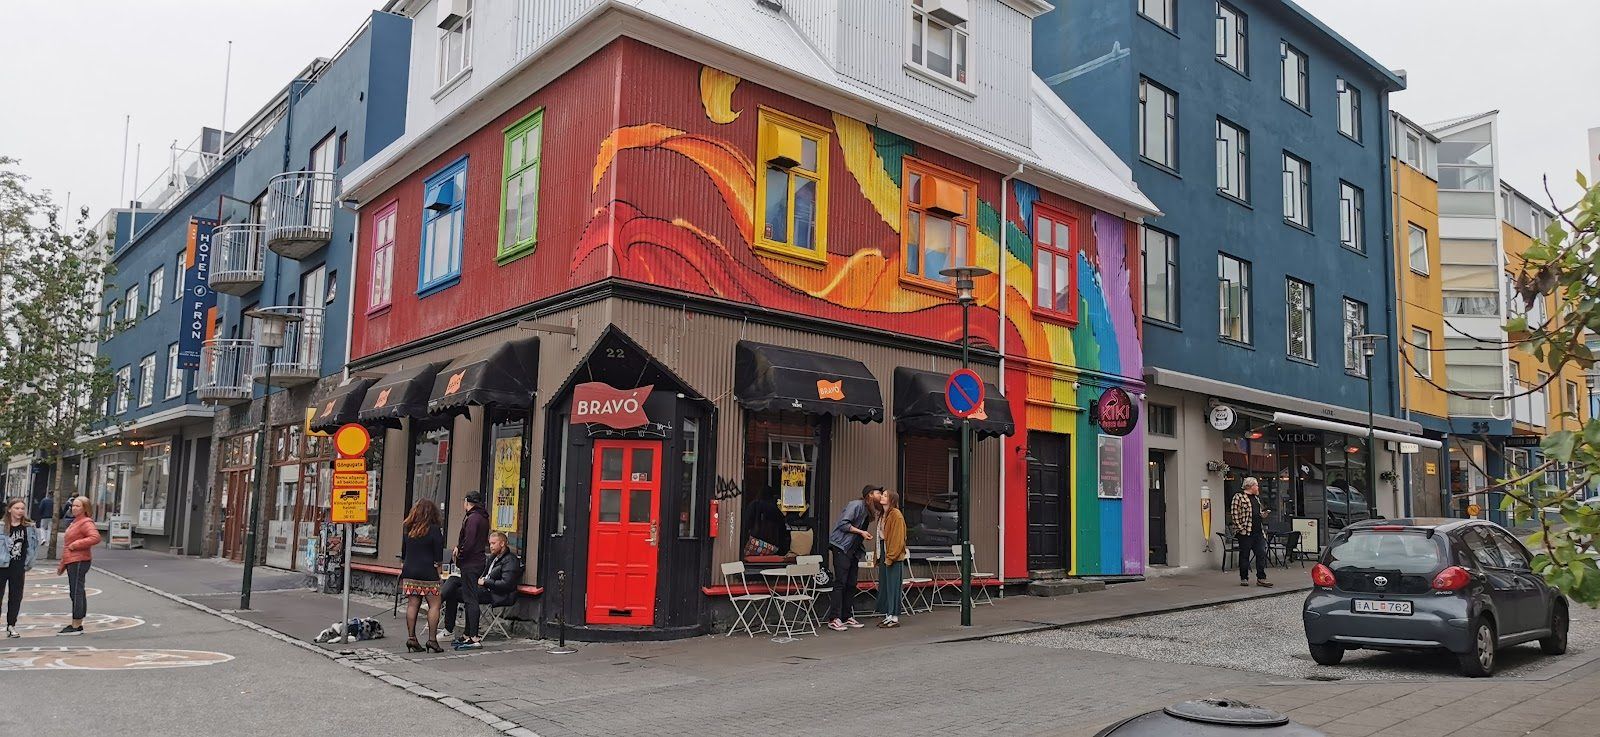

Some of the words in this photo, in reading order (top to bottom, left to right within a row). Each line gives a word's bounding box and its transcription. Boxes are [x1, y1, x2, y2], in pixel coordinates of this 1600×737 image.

[198, 234, 210, 280] HÓTEL
[191, 301, 203, 340] FRÓN
[606, 347, 625, 359] 22
[577, 391, 639, 416] BRAVÓ
[1101, 404, 1131, 421] KIKI
[1362, 601, 1379, 611] AL
[1388, 602, 1410, 613] 762
